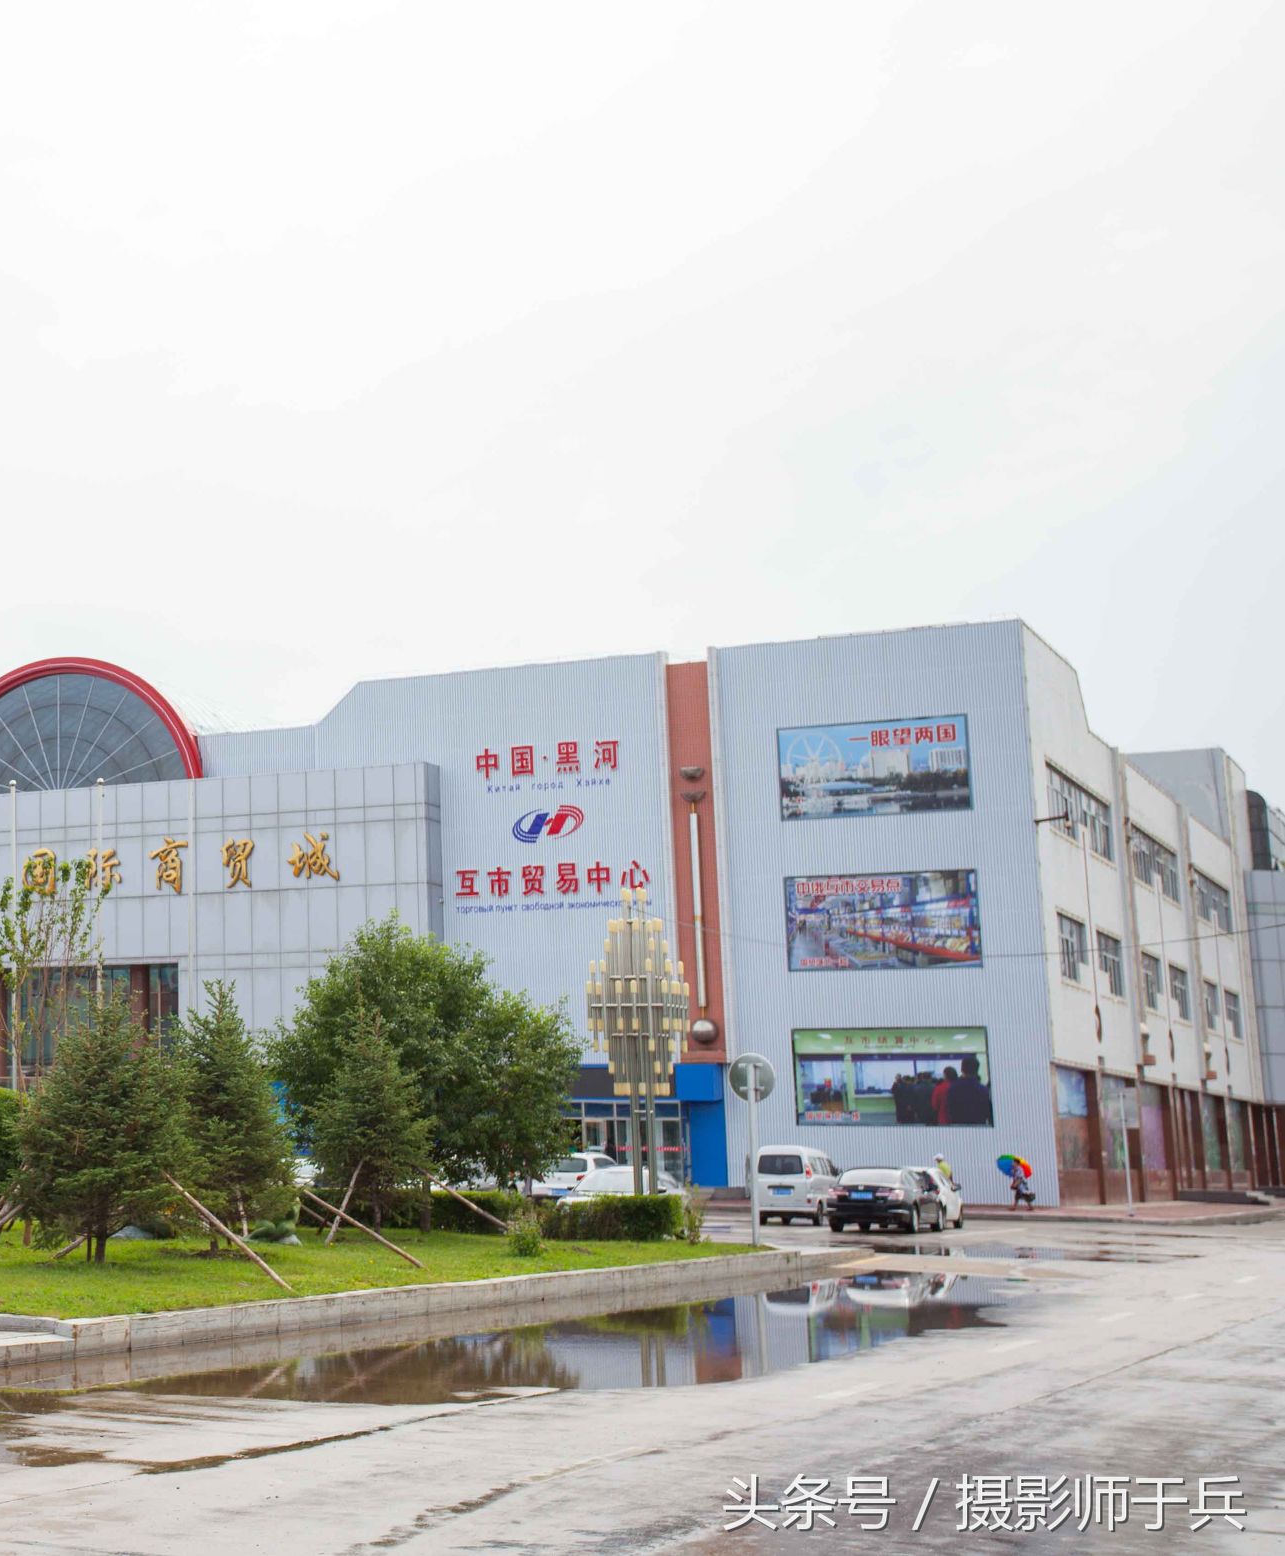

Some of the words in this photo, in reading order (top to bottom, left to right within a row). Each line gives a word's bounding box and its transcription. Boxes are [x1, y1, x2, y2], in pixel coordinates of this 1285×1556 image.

[847, 724, 957, 747] 一眼望两国
[476, 740, 619, 780] 中国·黑河
[487, 783, 521, 793] Китай
[532, 781, 564, 791] город
[455, 860, 651, 898] 互市贸易中心
